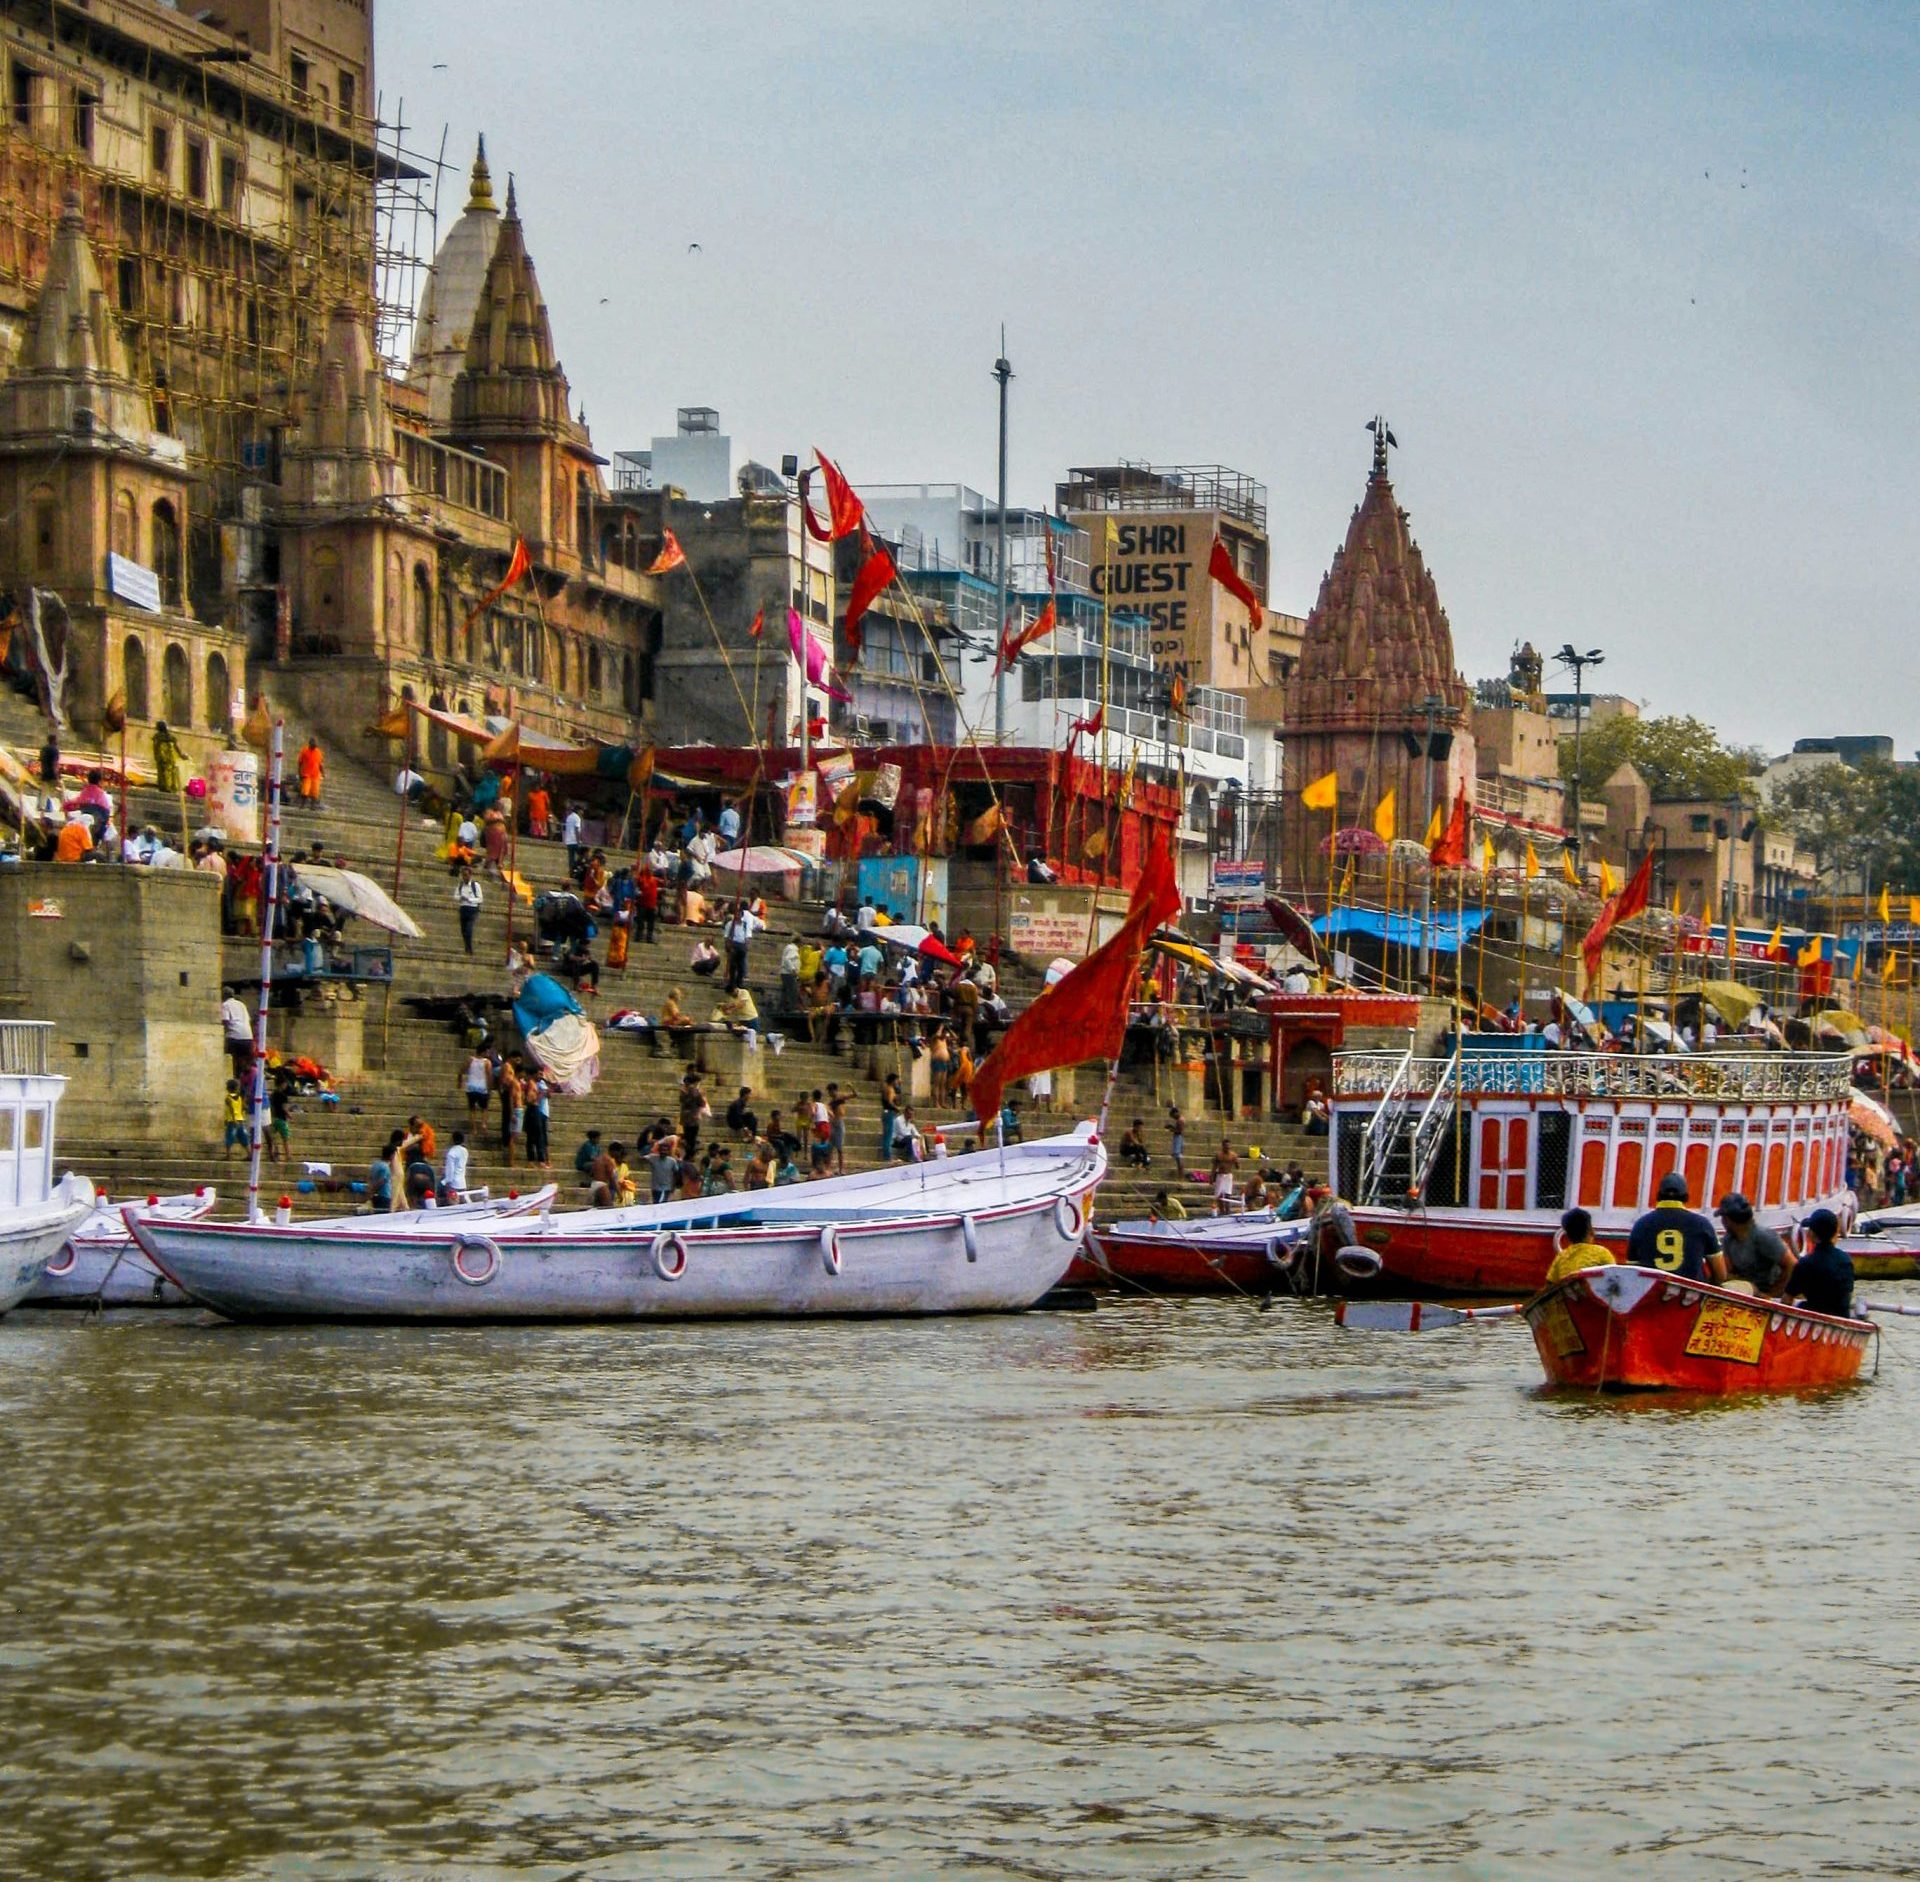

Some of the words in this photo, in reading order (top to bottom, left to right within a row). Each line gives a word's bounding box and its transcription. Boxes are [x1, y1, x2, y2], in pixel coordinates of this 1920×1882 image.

[1117, 524, 1186, 556] SHRI
[1089, 561, 1193, 595] GUEST
[1654, 1229, 1684, 1271] 9
